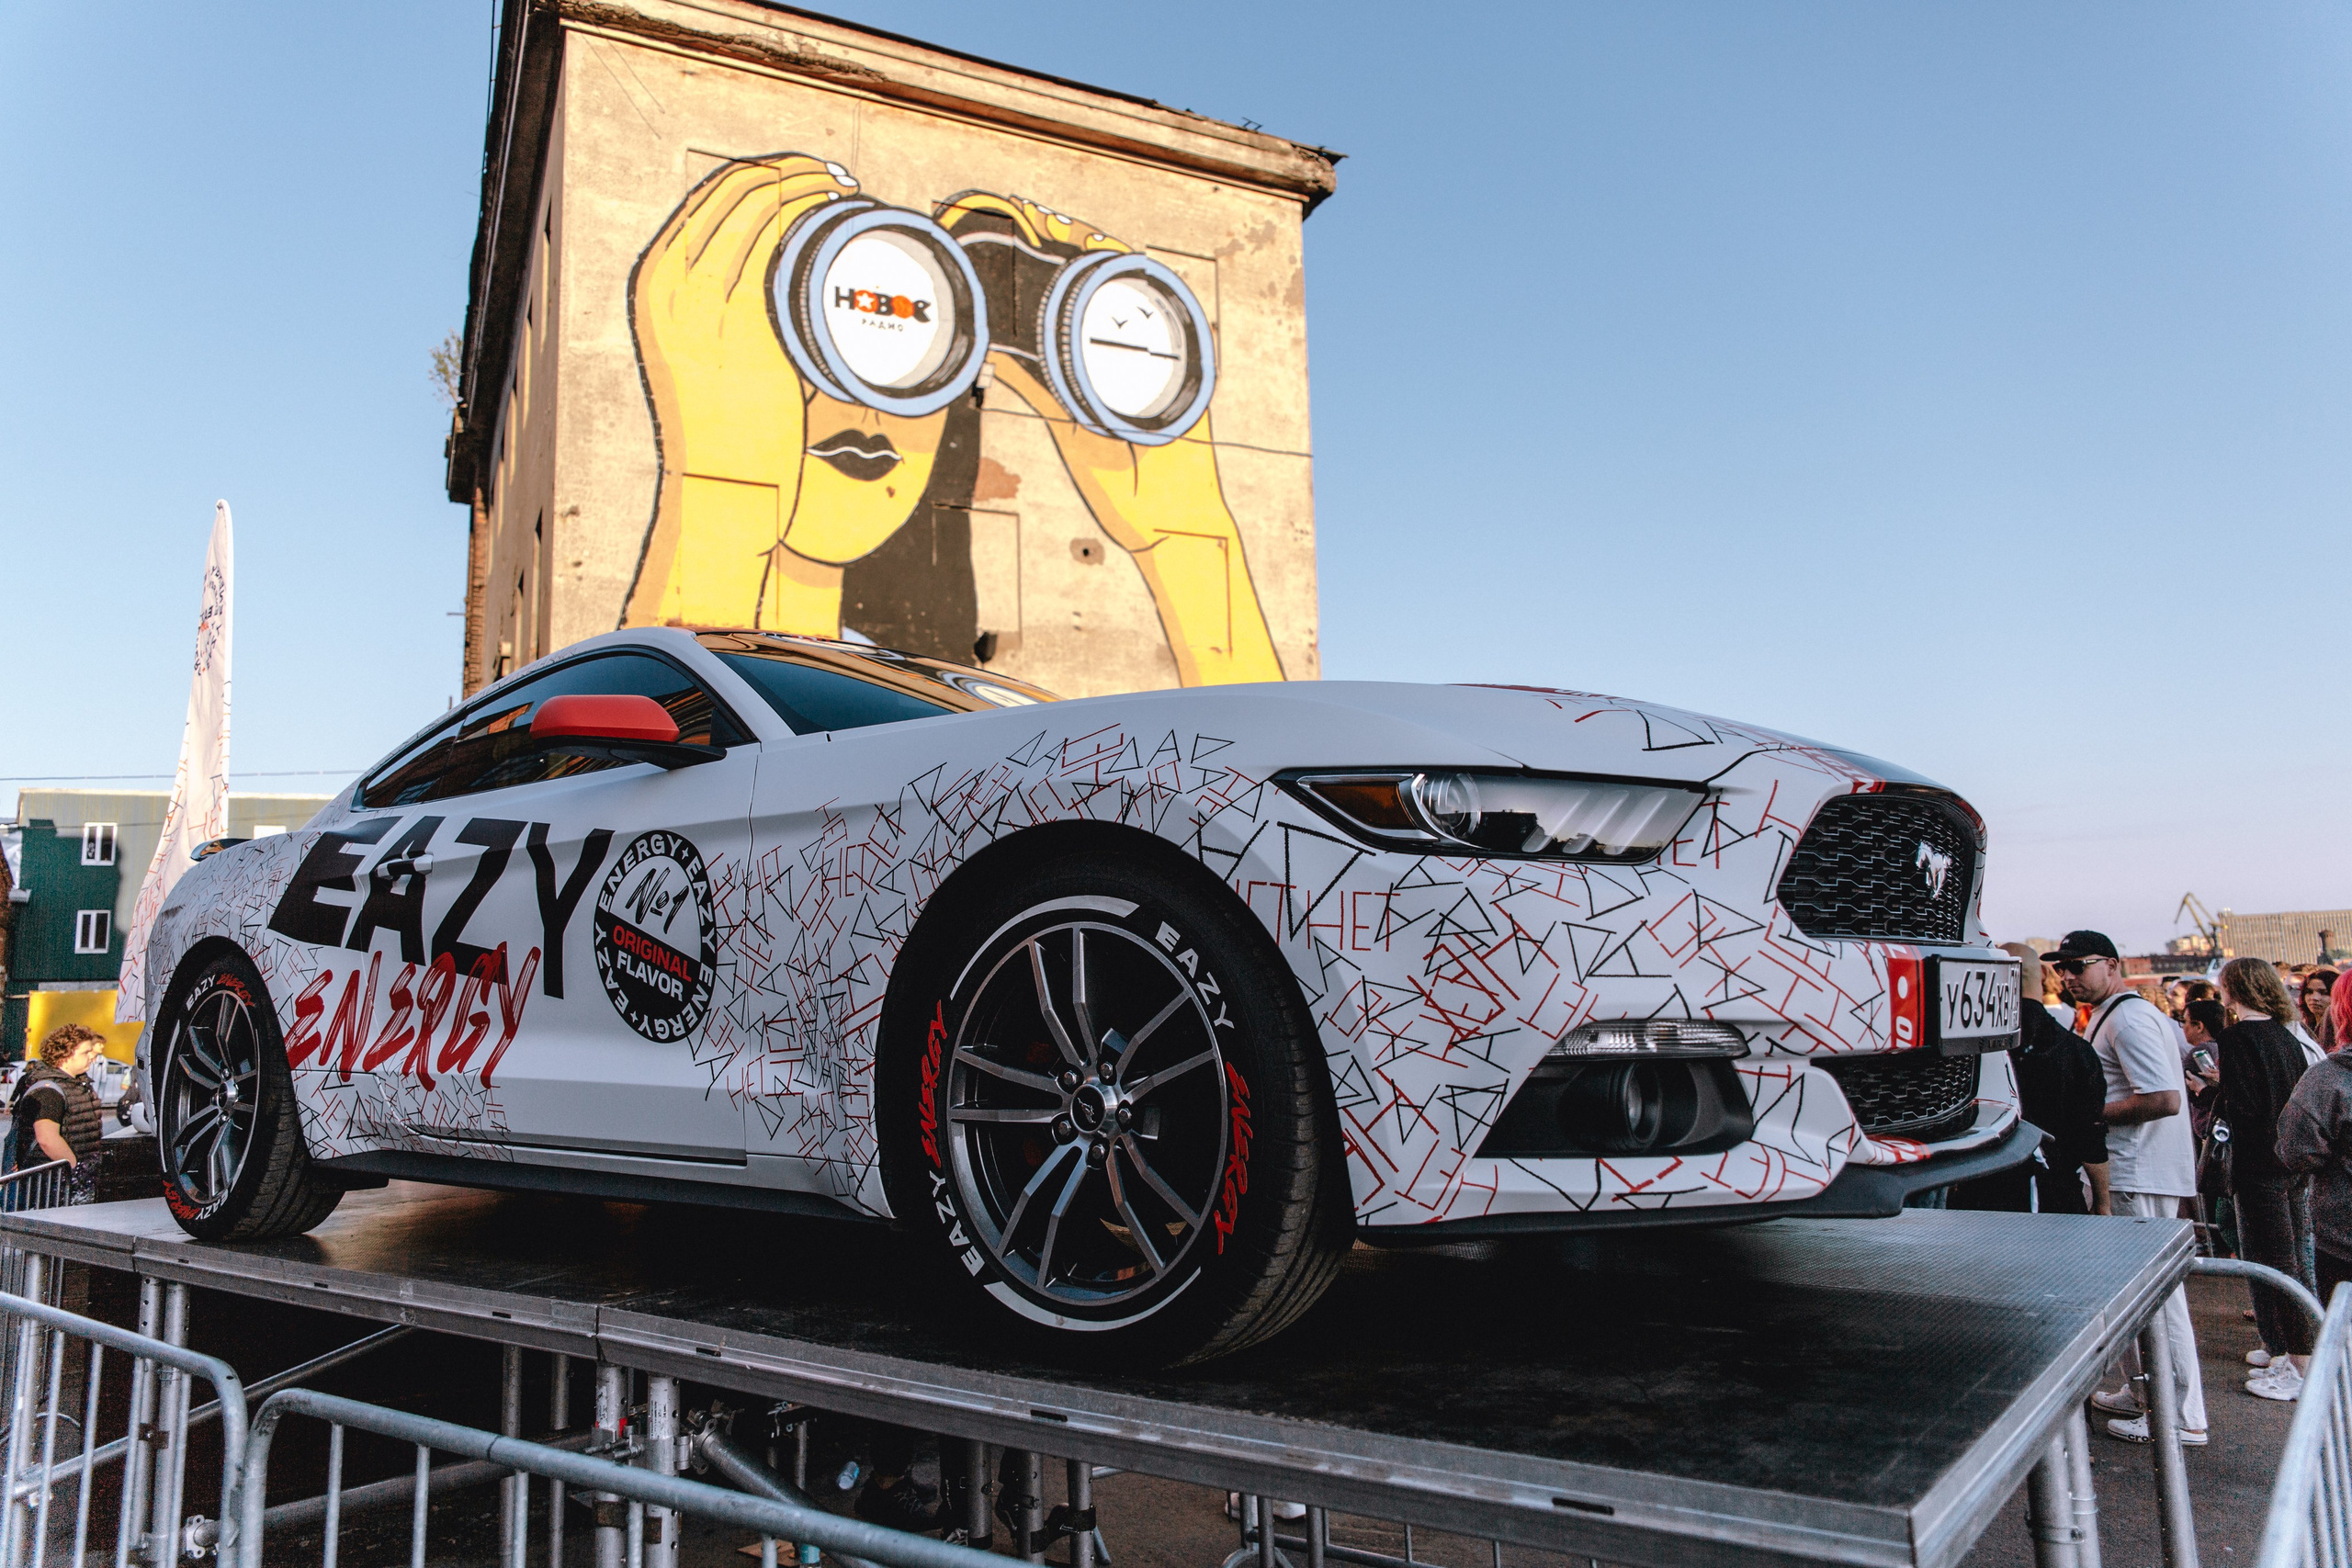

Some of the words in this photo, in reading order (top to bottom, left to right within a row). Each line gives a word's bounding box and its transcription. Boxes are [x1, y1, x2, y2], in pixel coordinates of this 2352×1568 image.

[267, 816, 616, 999] EAZY
[598, 833, 683, 913] ENERGY
[685, 855, 717, 953] EAZY
[186, 974, 216, 1011] EAZY
[595, 921, 629, 1014] EAZY
[613, 925, 692, 982] ORIGINAL
[616, 950, 684, 1002] FLAVOR
[1155, 920, 1235, 1029] EAZY
[285, 942, 541, 1091] ENERGY
[638, 962, 714, 1040] ENERGY
[195, 1189, 229, 1221] EAZY
[928, 1169, 987, 1277] EAZY
